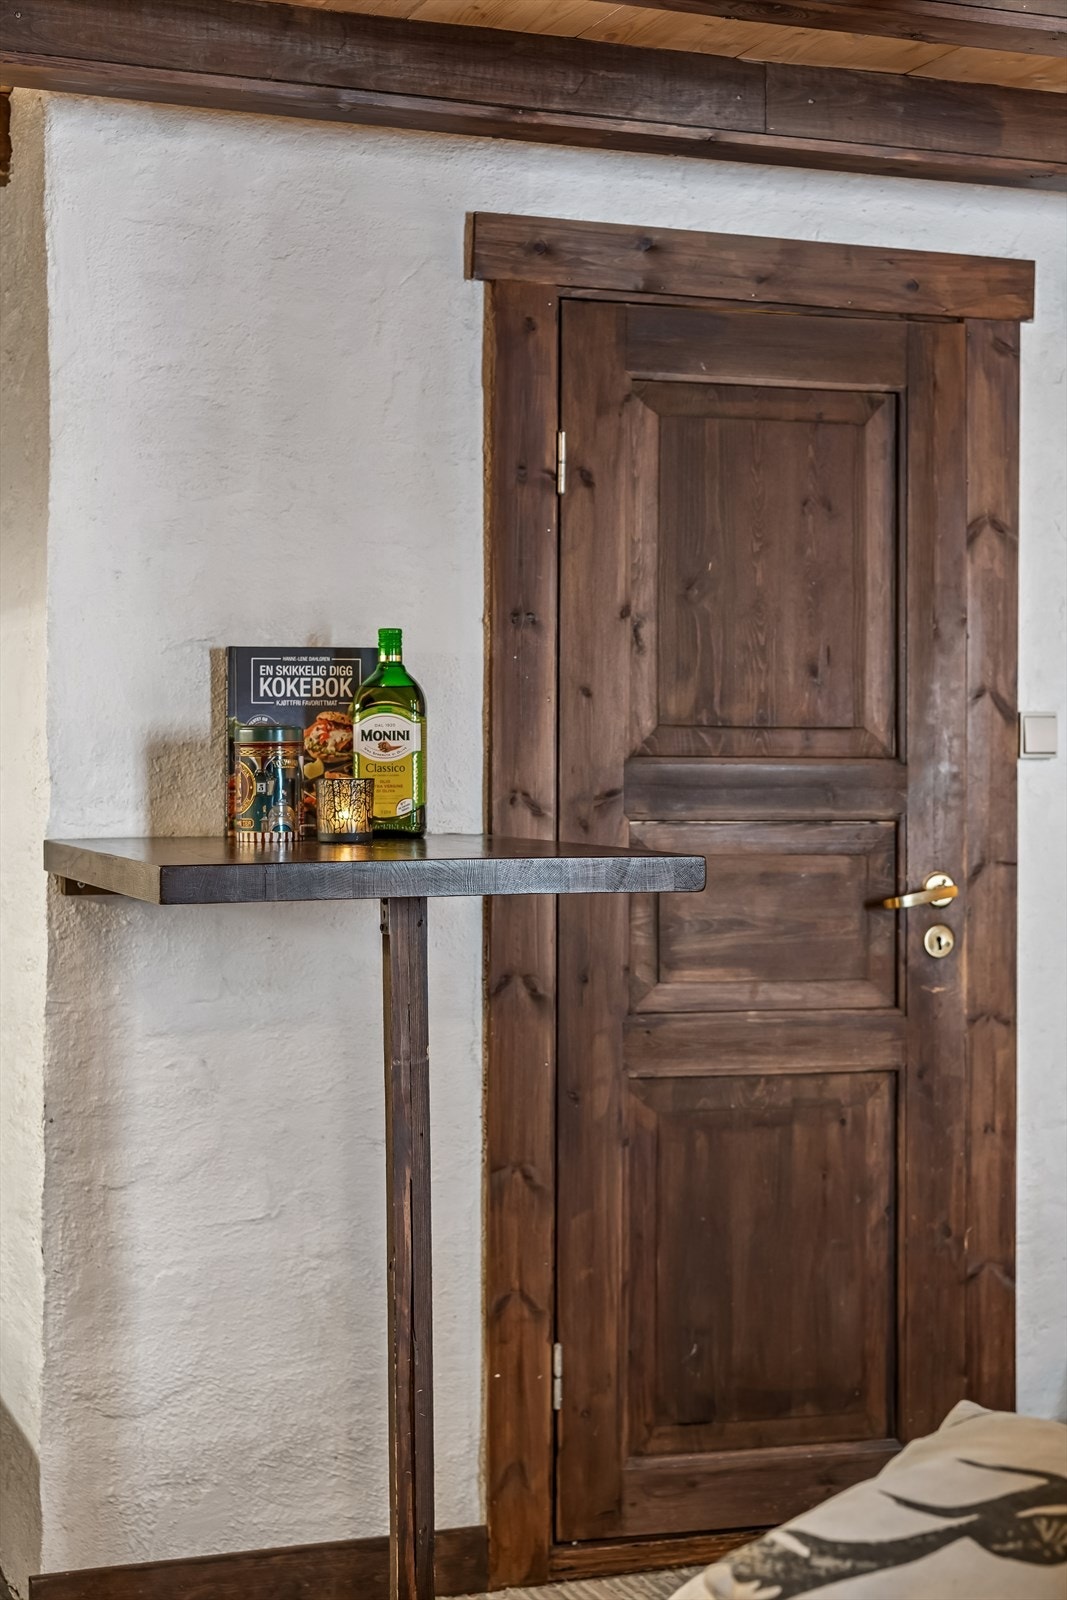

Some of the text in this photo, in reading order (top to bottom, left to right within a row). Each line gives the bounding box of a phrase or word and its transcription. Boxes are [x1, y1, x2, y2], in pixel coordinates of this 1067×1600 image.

[259, 665, 353, 676] EN SKIKKELIG DIGG
[259, 677, 353, 698] KOKEBOK
[360, 729, 410, 742] MONINI
[365, 763, 406, 773] Classico
